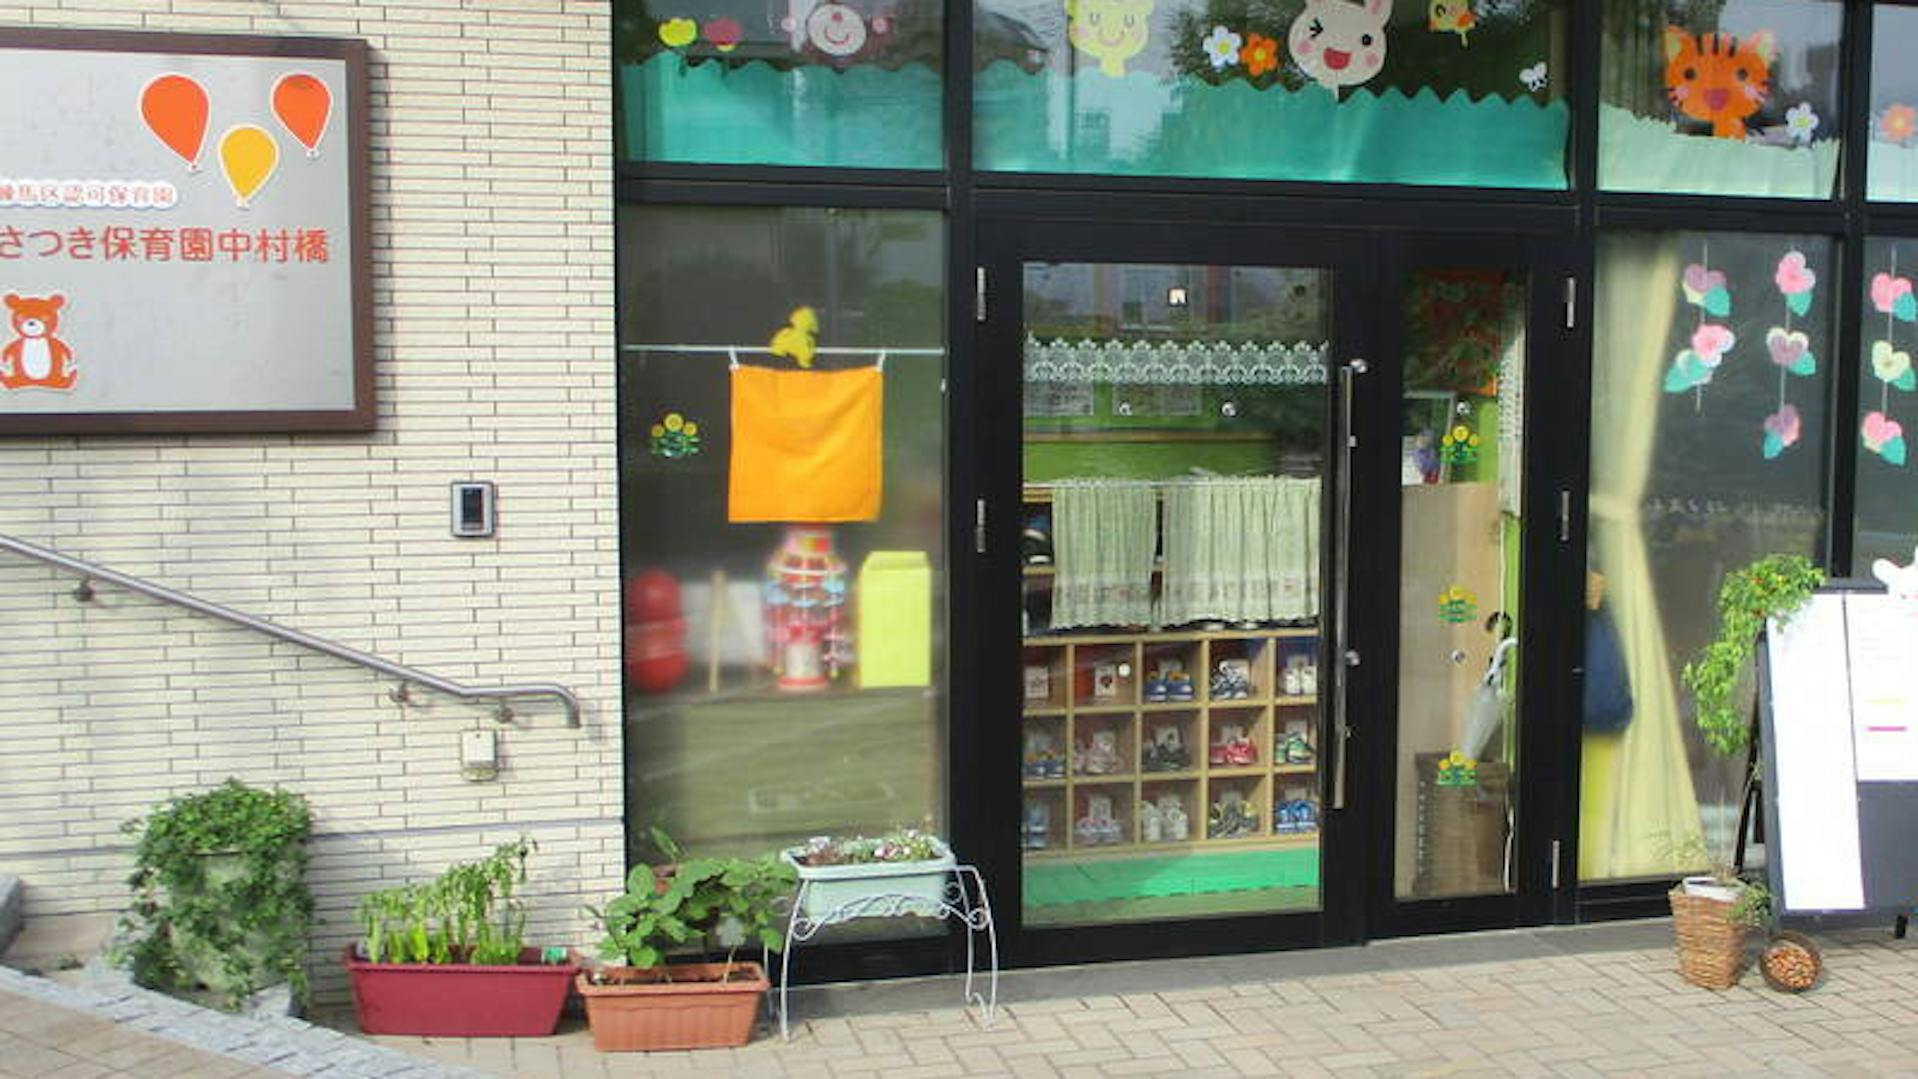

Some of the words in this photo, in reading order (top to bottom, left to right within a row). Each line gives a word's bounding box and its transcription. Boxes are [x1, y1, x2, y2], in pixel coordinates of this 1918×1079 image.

[0, 225, 330, 263] さつき保育園中村橋
